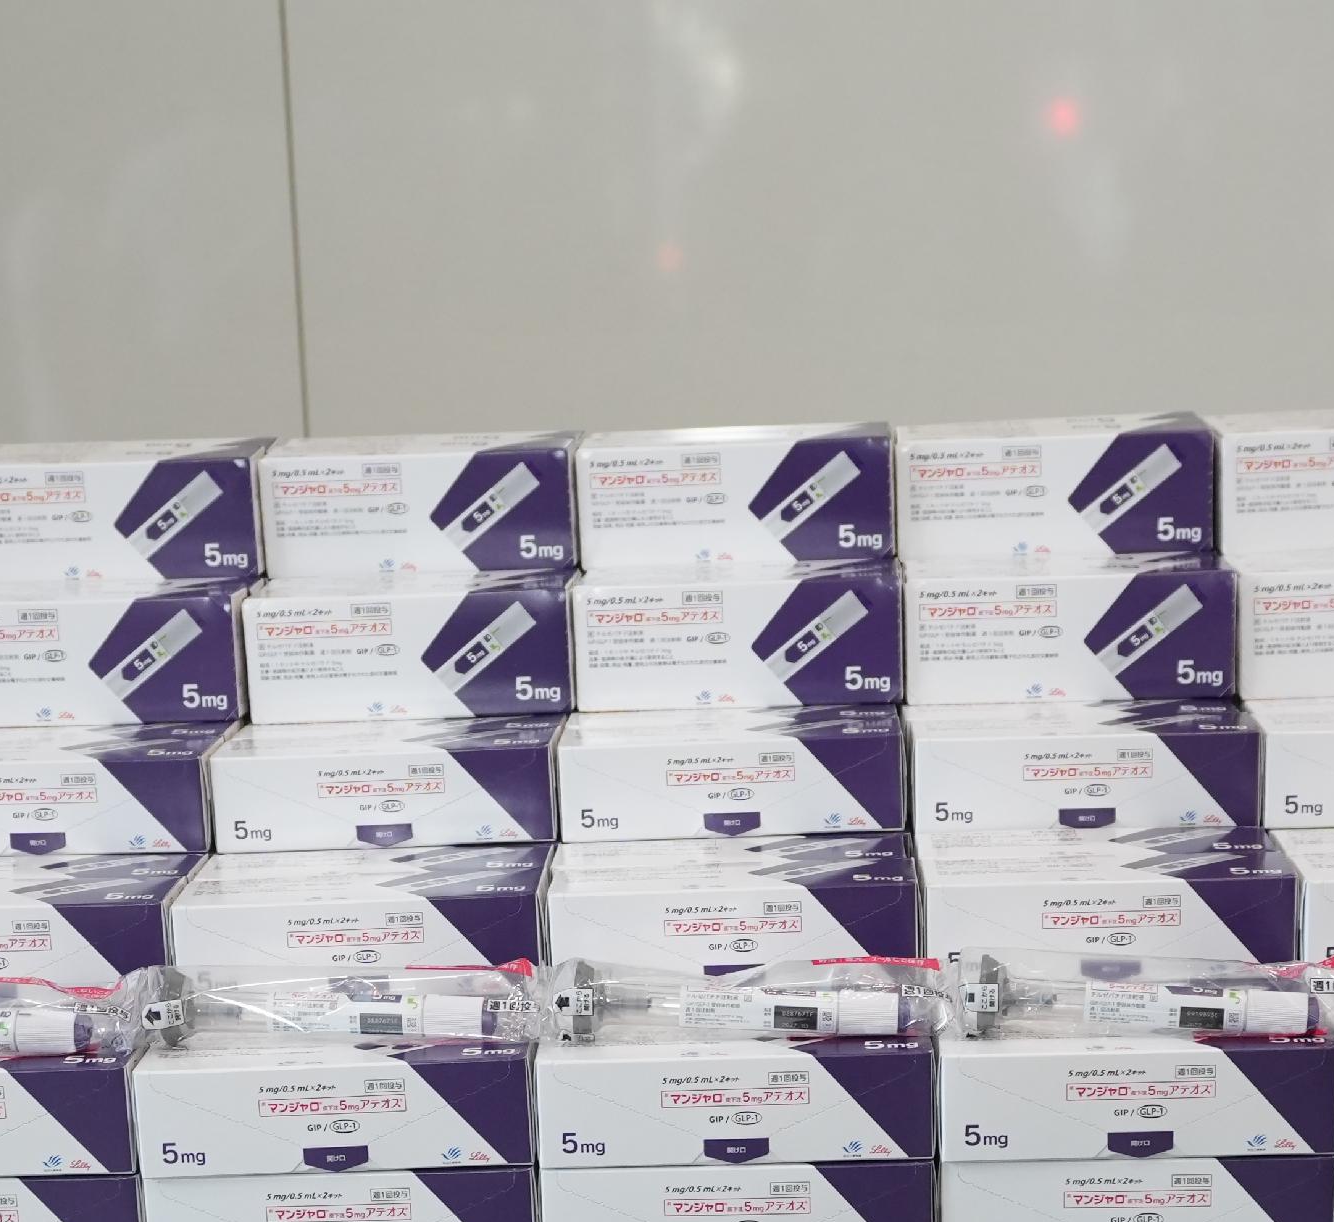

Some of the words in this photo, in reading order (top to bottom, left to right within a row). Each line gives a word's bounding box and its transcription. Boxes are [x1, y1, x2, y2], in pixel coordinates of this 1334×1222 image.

[839, 524, 882, 550] 5mg
[1157, 517, 1202, 542] 5mg
[205, 543, 248, 568] 5mg
[520, 535, 563, 560] 5mg
[845, 666, 890, 692] 5mg
[1177, 660, 1223, 686] 5mg
[183, 684, 227, 710] 5mg
[516, 676, 561, 702] 5mg
